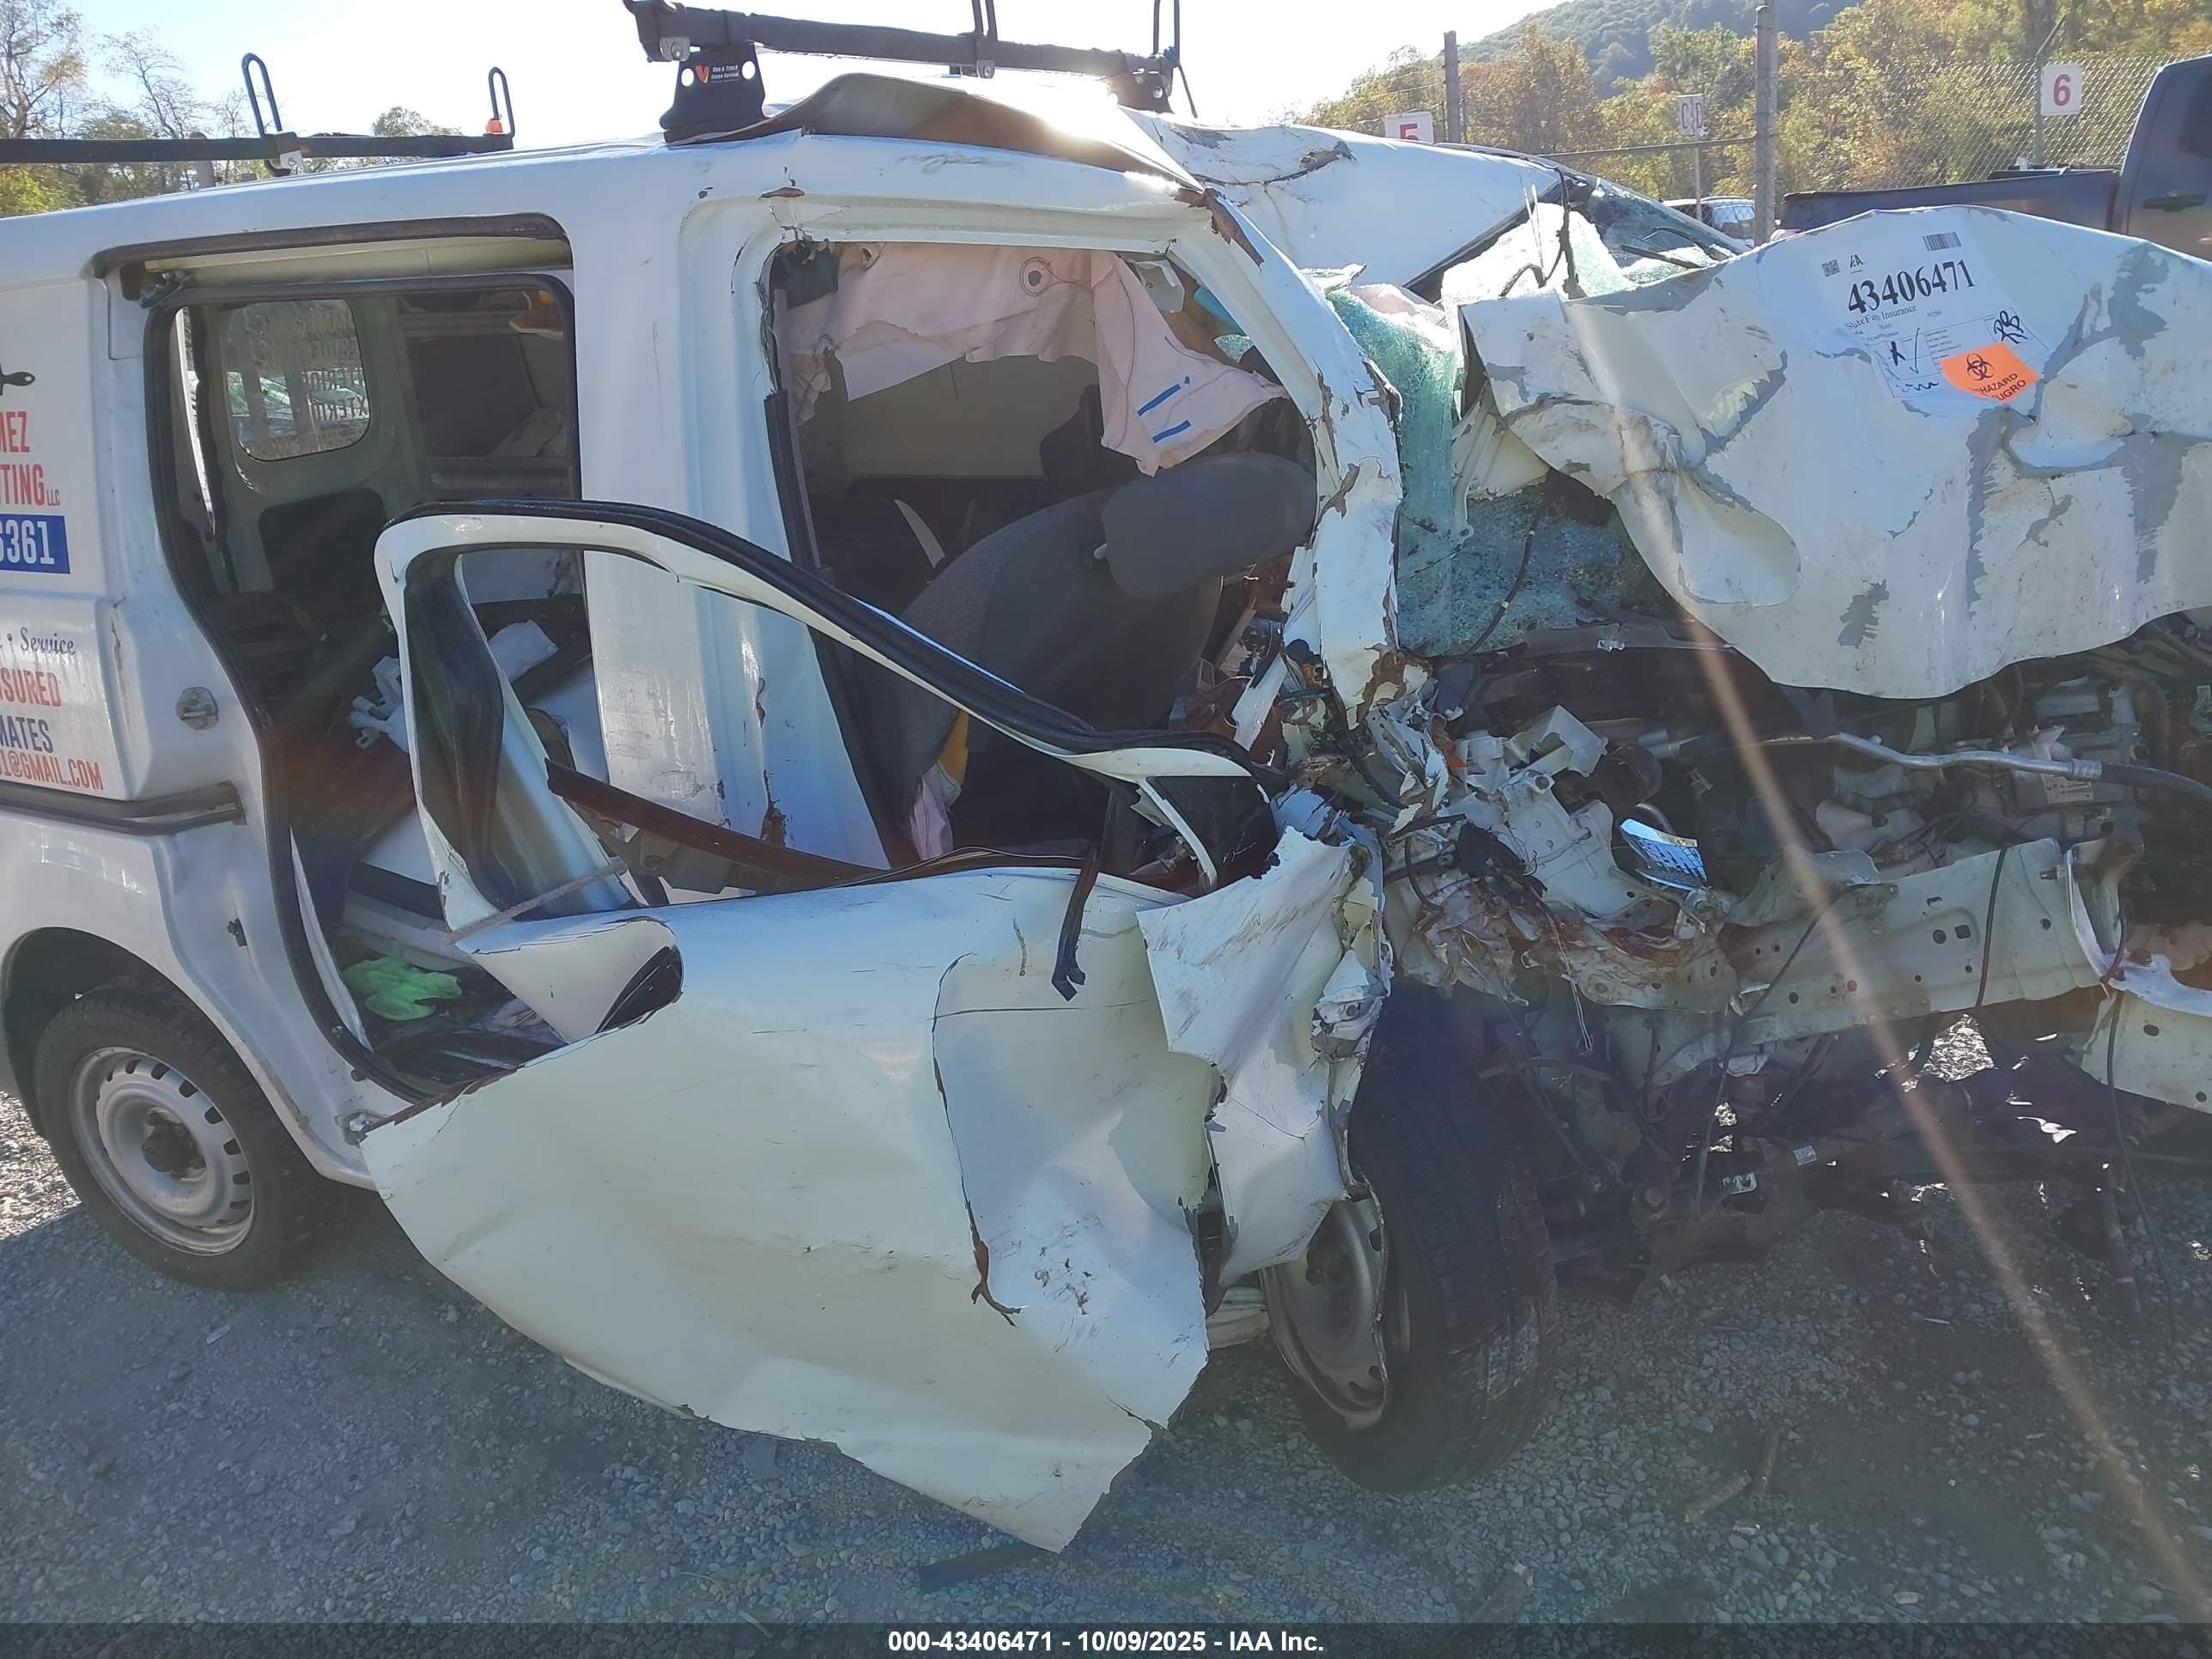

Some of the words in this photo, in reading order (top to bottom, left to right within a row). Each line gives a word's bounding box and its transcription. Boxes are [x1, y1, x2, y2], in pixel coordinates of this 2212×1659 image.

[2053, 74, 2071, 106] 6
[1848, 259, 1976, 314] 43406471
[1881, 305, 1917, 320] Insurance
[1973, 373, 2018, 393] HAZARD
[0, 464, 46, 507] TING
[46, 489, 61, 507] LLC
[20, 627, 76, 655] Service
[0, 667, 62, 708] SURED
[0, 750, 104, 791] 1@GMAIL.COM
